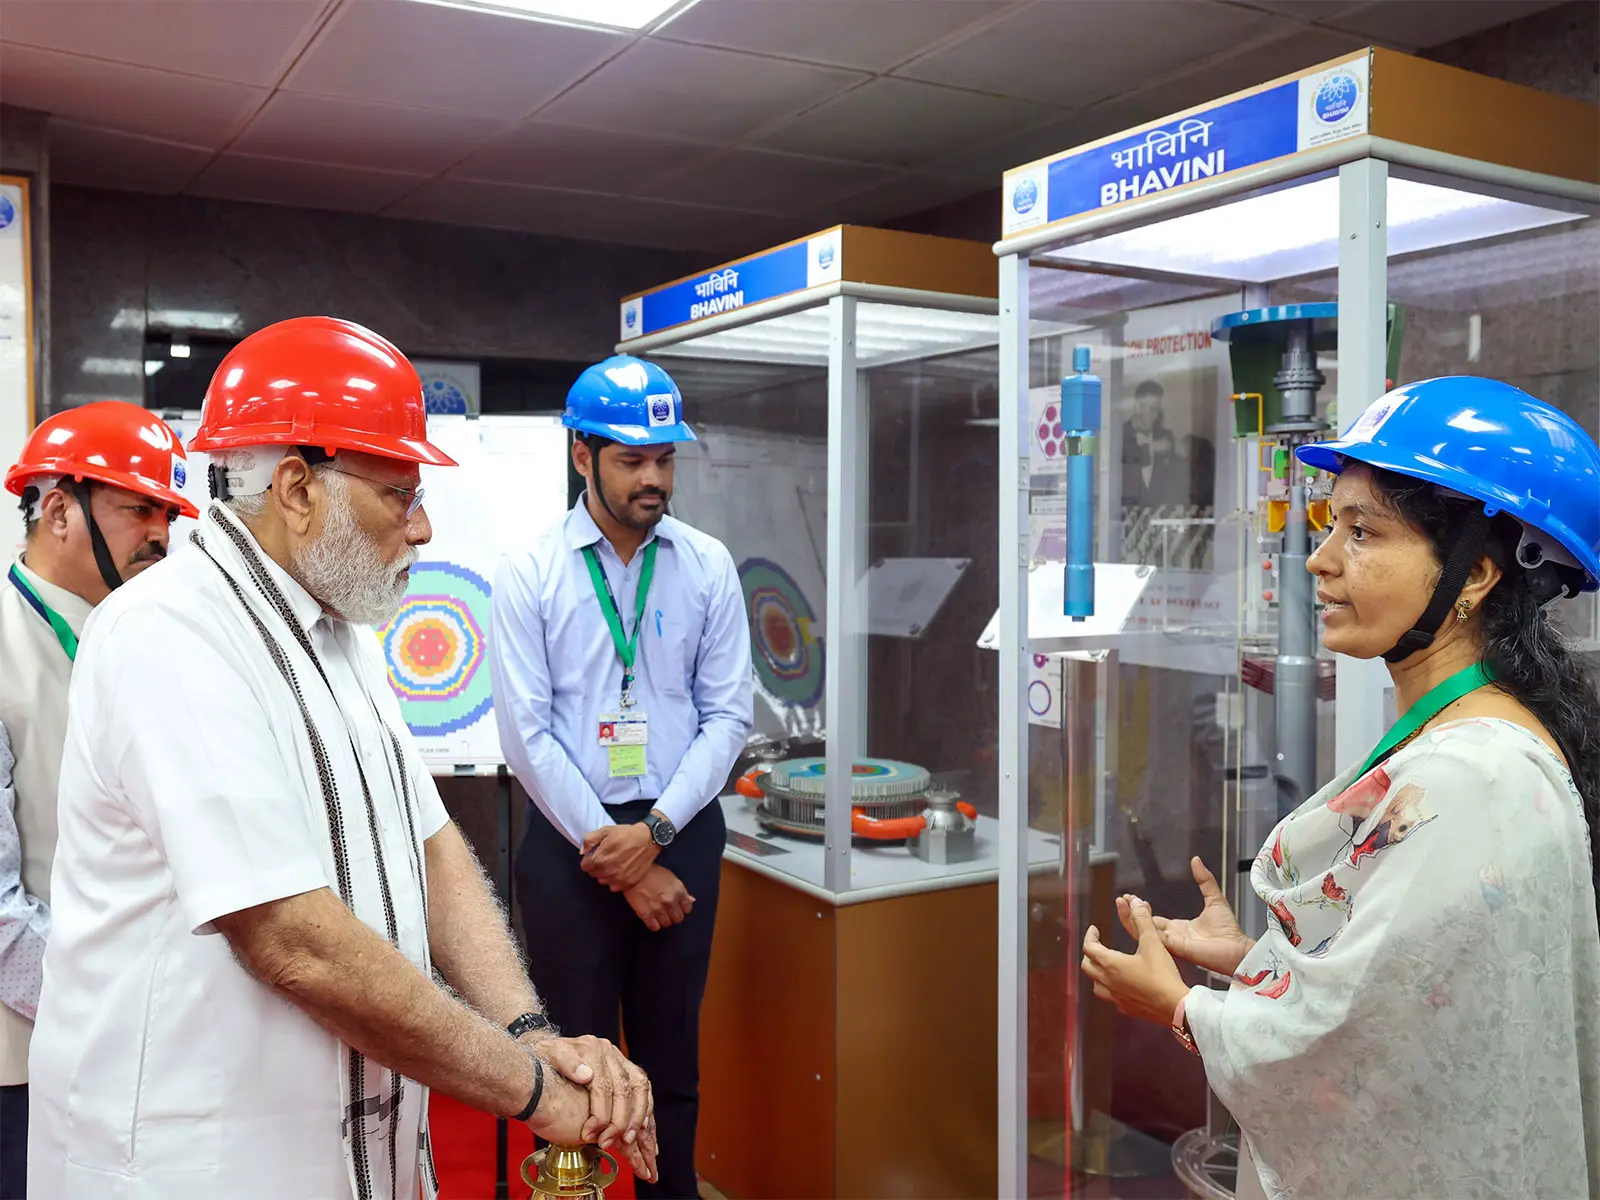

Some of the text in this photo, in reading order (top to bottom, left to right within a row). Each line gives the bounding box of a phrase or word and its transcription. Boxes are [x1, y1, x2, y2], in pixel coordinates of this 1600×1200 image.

[1111, 119, 1213, 170] भाविनि
[1100, 149, 1225, 208] BHAVINI
[694, 268, 739, 298] भाविनि
[690, 291, 744, 320] BHAVINI
[1146, 331, 1212, 356] PROTECTION
